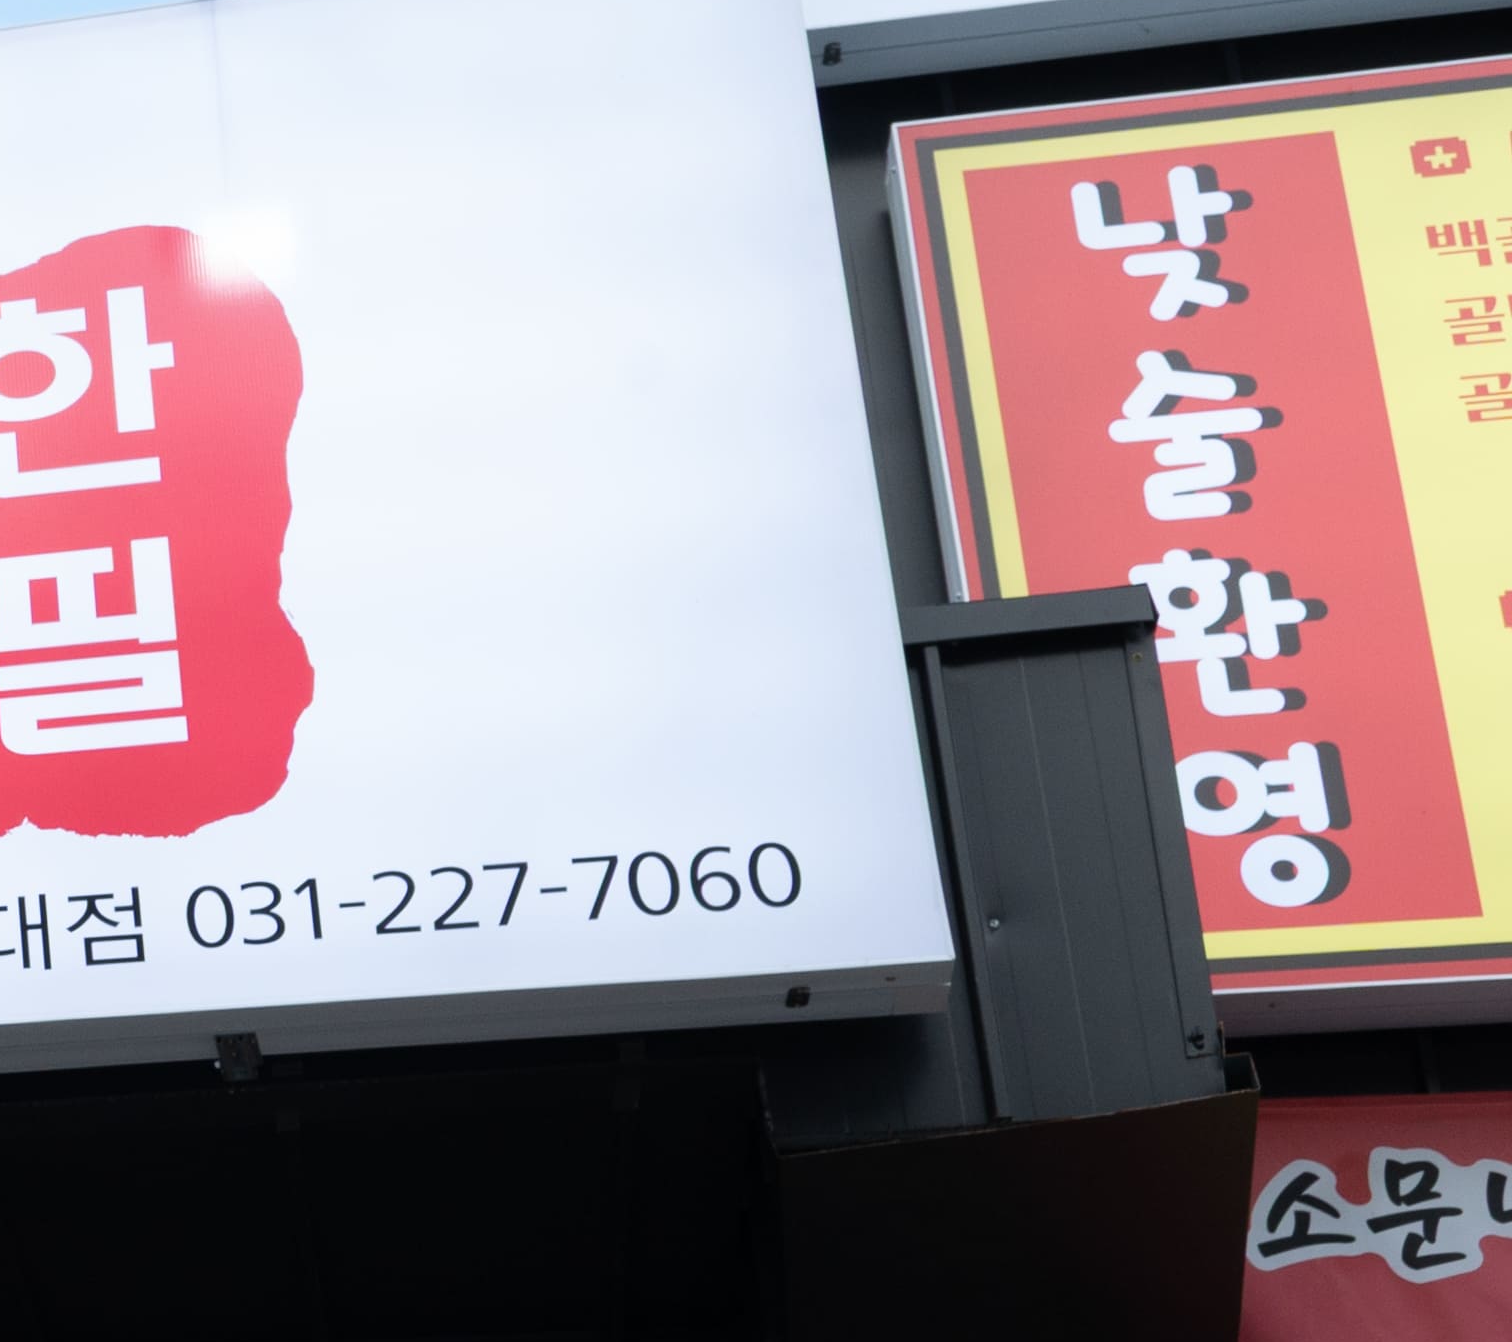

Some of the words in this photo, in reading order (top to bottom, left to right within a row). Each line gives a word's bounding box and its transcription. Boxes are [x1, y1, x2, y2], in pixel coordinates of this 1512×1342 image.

[1444, 293, 1512, 346] 골
[1071, 163, 1334, 908] 낮술환영
[184, 840, 805, 950] 031-227-7060
[1257, 1158, 1512, 1271] 소문
